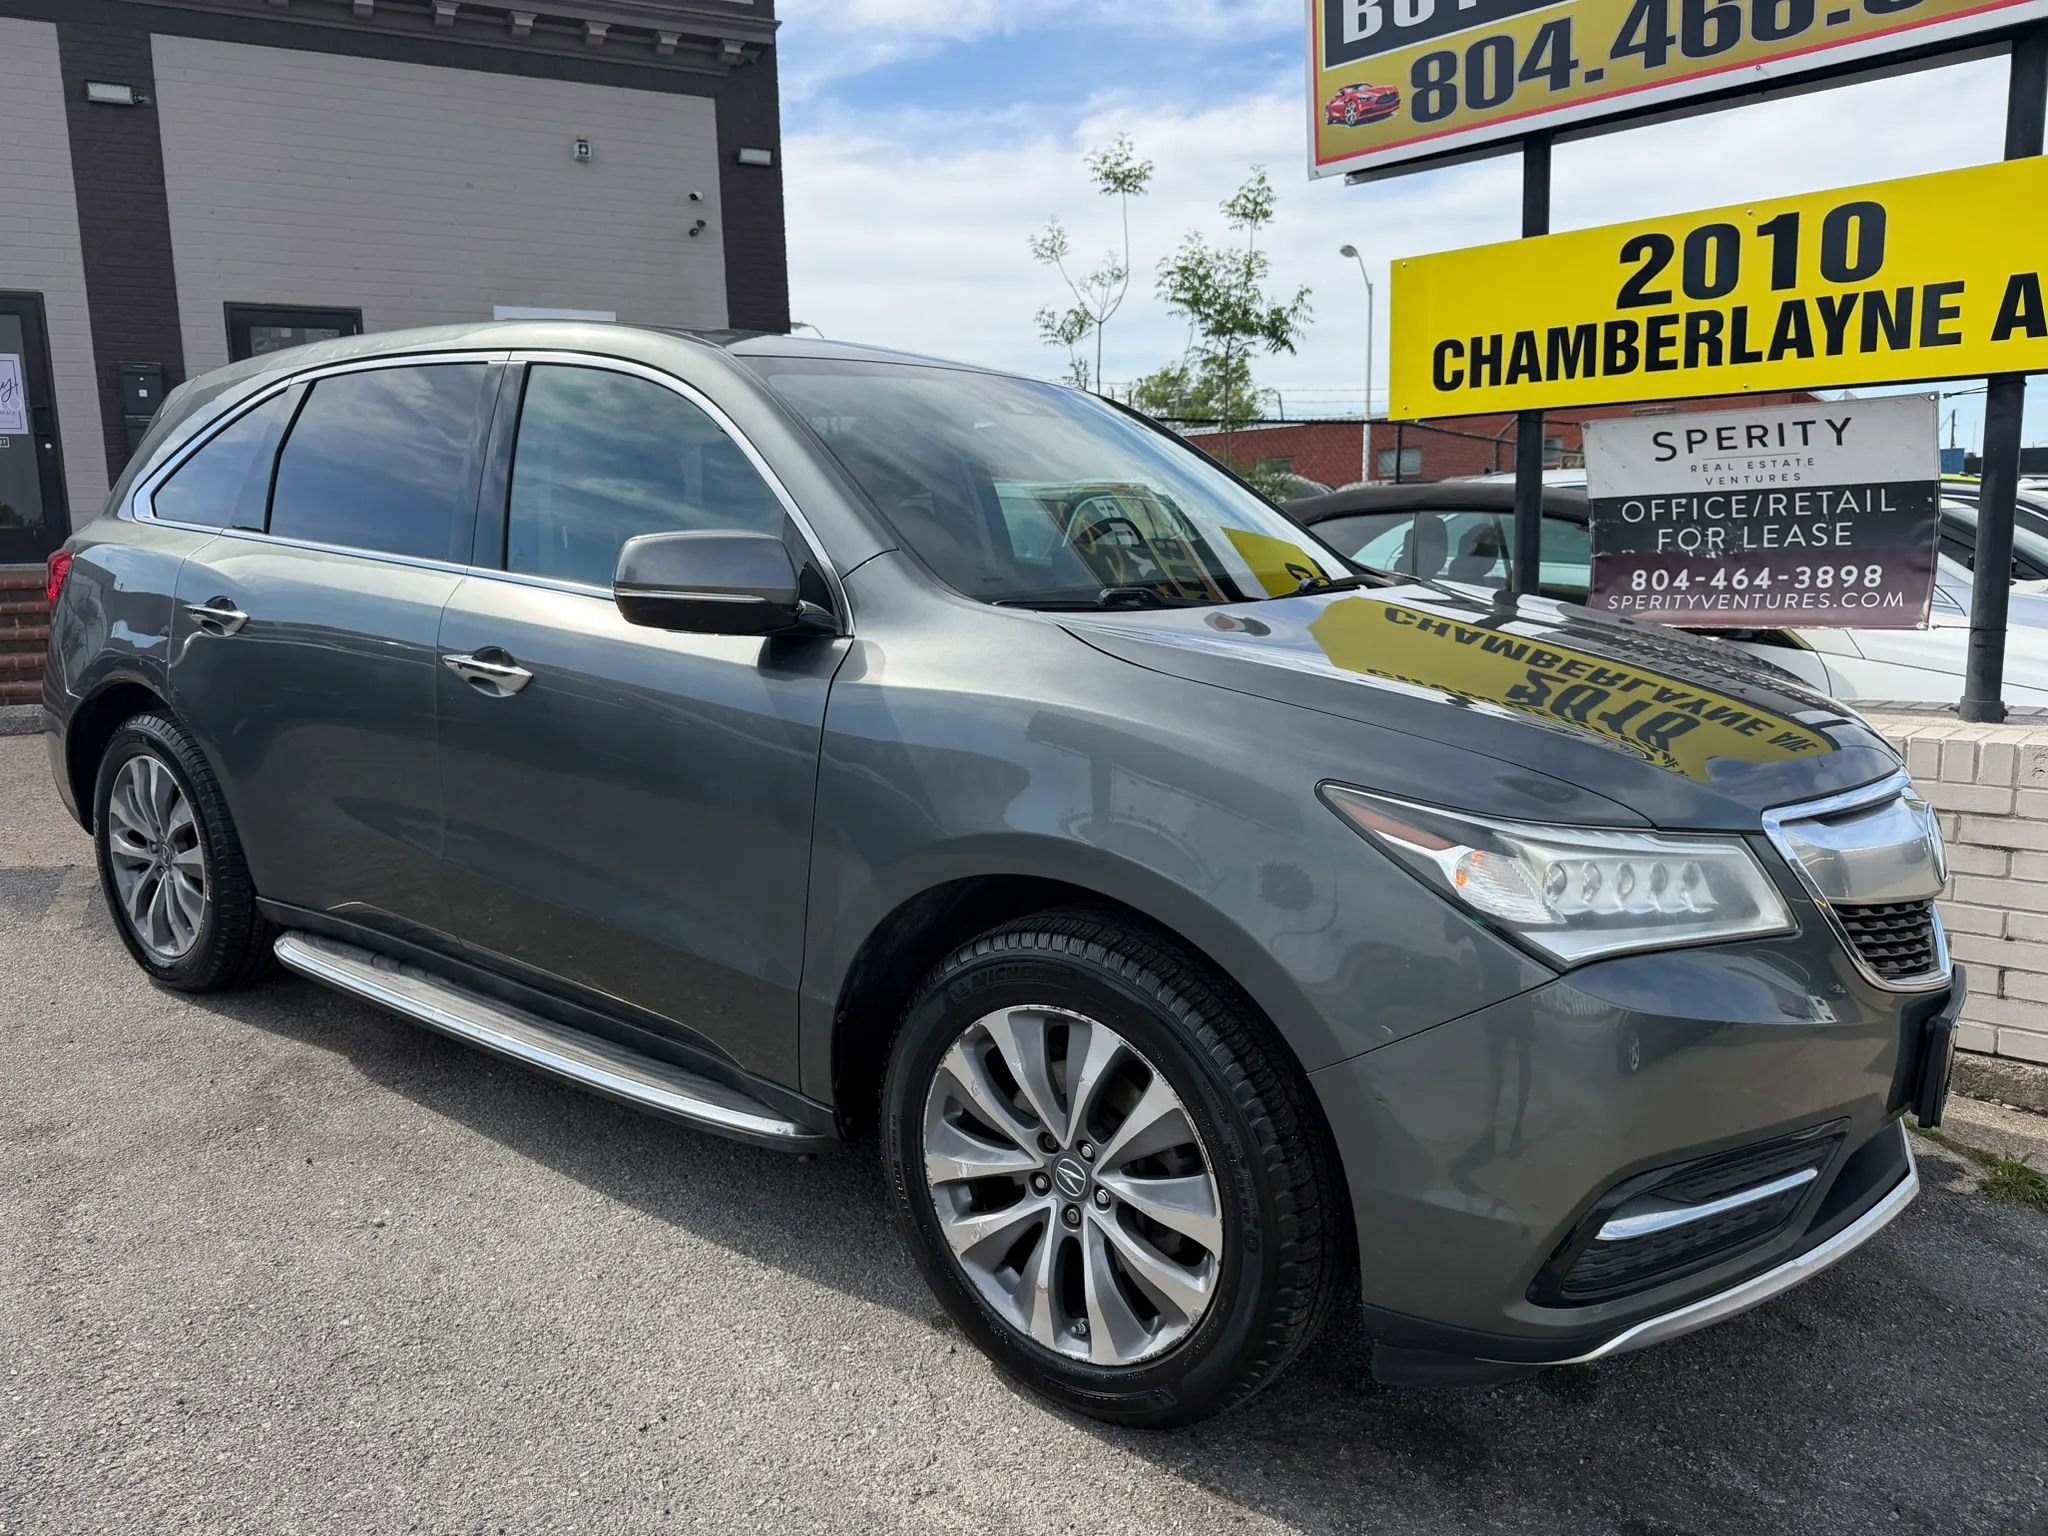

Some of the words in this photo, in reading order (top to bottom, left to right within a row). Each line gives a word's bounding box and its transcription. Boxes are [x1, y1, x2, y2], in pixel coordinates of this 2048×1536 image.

[1408, 0, 1926, 124] 804.466.
[1615, 200, 1887, 310] 2010
[1432, 280, 1965, 392] CHAMBERLAYNE
[1990, 271, 2048, 342] A
[1652, 417, 1852, 462] SPERITY
[1690, 462, 1735, 474] REAL
[1747, 457, 1816, 471] ESTATE
[1704, 472, 1803, 487] VENTURES
[1621, 488, 1897, 524] OFFICE/RETAIL
[1656, 526, 1726, 551] FOR
[1743, 521, 1854, 549] LEASE
[1630, 564, 1883, 592] 804-464-3898
[1606, 591, 1904, 611] SPERITYVENTURES.COM
